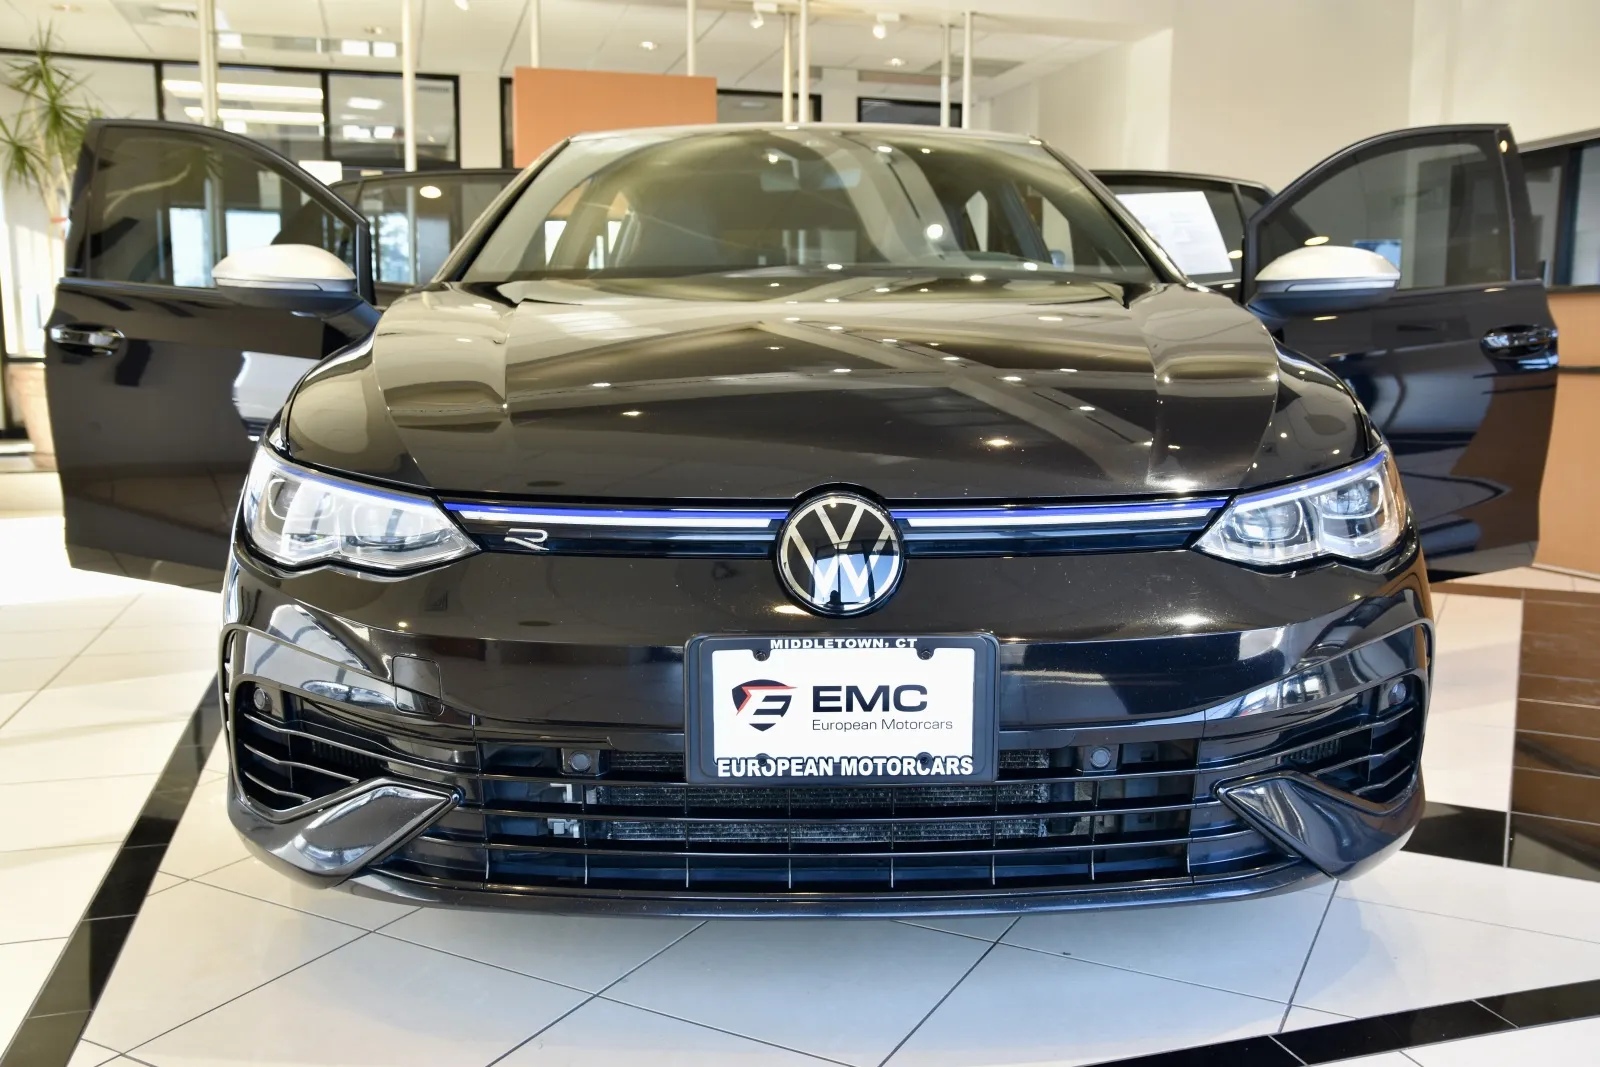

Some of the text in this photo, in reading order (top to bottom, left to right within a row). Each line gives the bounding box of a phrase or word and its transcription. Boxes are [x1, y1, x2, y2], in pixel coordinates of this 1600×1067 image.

[504, 528, 549, 550] R
[770, 638, 918, 649] MIDDLETOWN, CT
[812, 684, 928, 713] EMC
[812, 718, 953, 732] European Motorcars
[717, 757, 974, 777] EUROPEAN MOTORCARS
